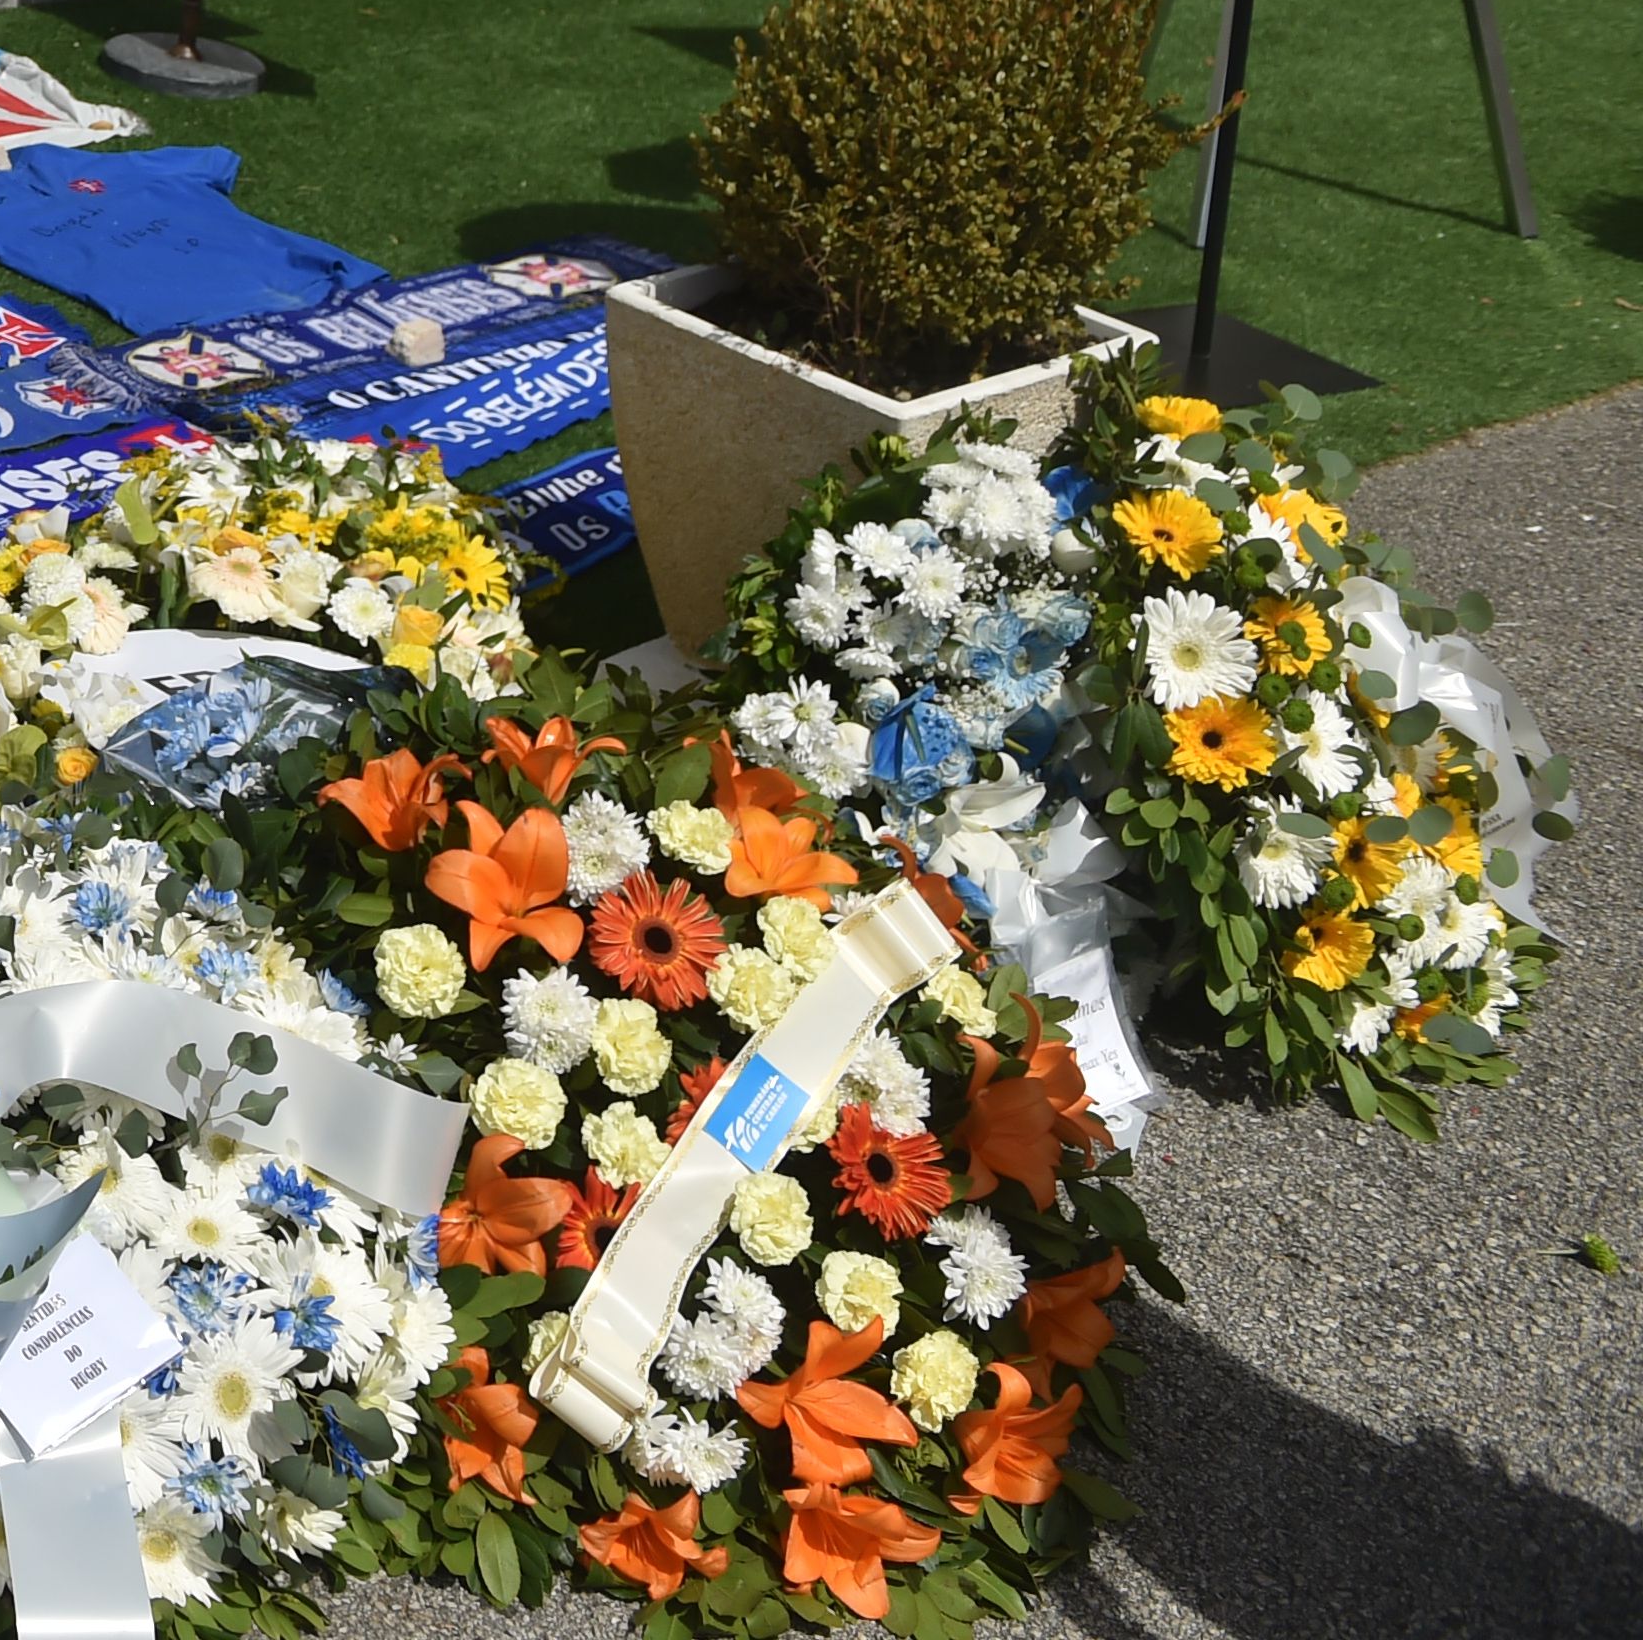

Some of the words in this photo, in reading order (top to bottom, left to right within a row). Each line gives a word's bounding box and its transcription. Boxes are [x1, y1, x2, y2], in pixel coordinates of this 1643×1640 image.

[752, 1091, 777, 1124] CENTRAL
[21, 1306, 94, 1361] CONDOLÊNCIAS
[64, 1344, 83, 1363] DO
[70, 1357, 108, 1390] RUGBY
